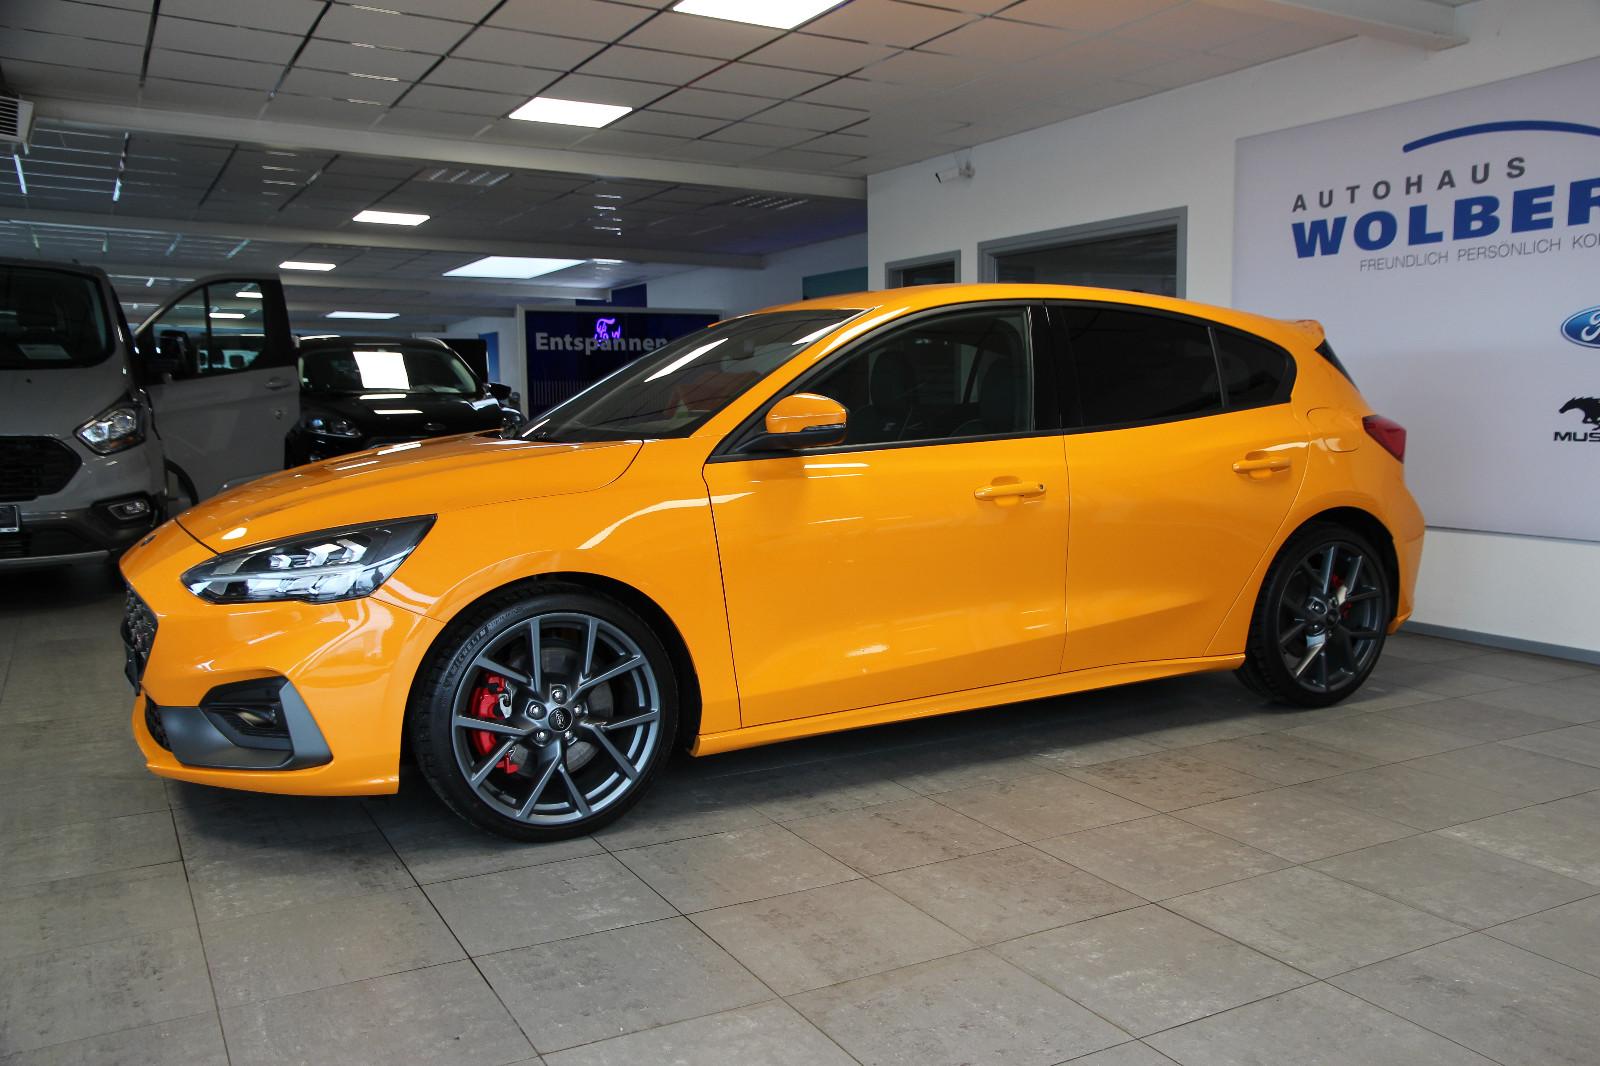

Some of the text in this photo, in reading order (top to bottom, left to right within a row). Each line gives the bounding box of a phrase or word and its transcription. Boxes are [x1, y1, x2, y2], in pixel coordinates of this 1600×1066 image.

[1292, 157, 1526, 212] AUTOHAUS
[1291, 178, 1600, 259] WOLBER
[1359, 233, 1600, 272] FREUNDLICH PERSÖNLICH KO
[1553, 431, 1600, 442] MUS
